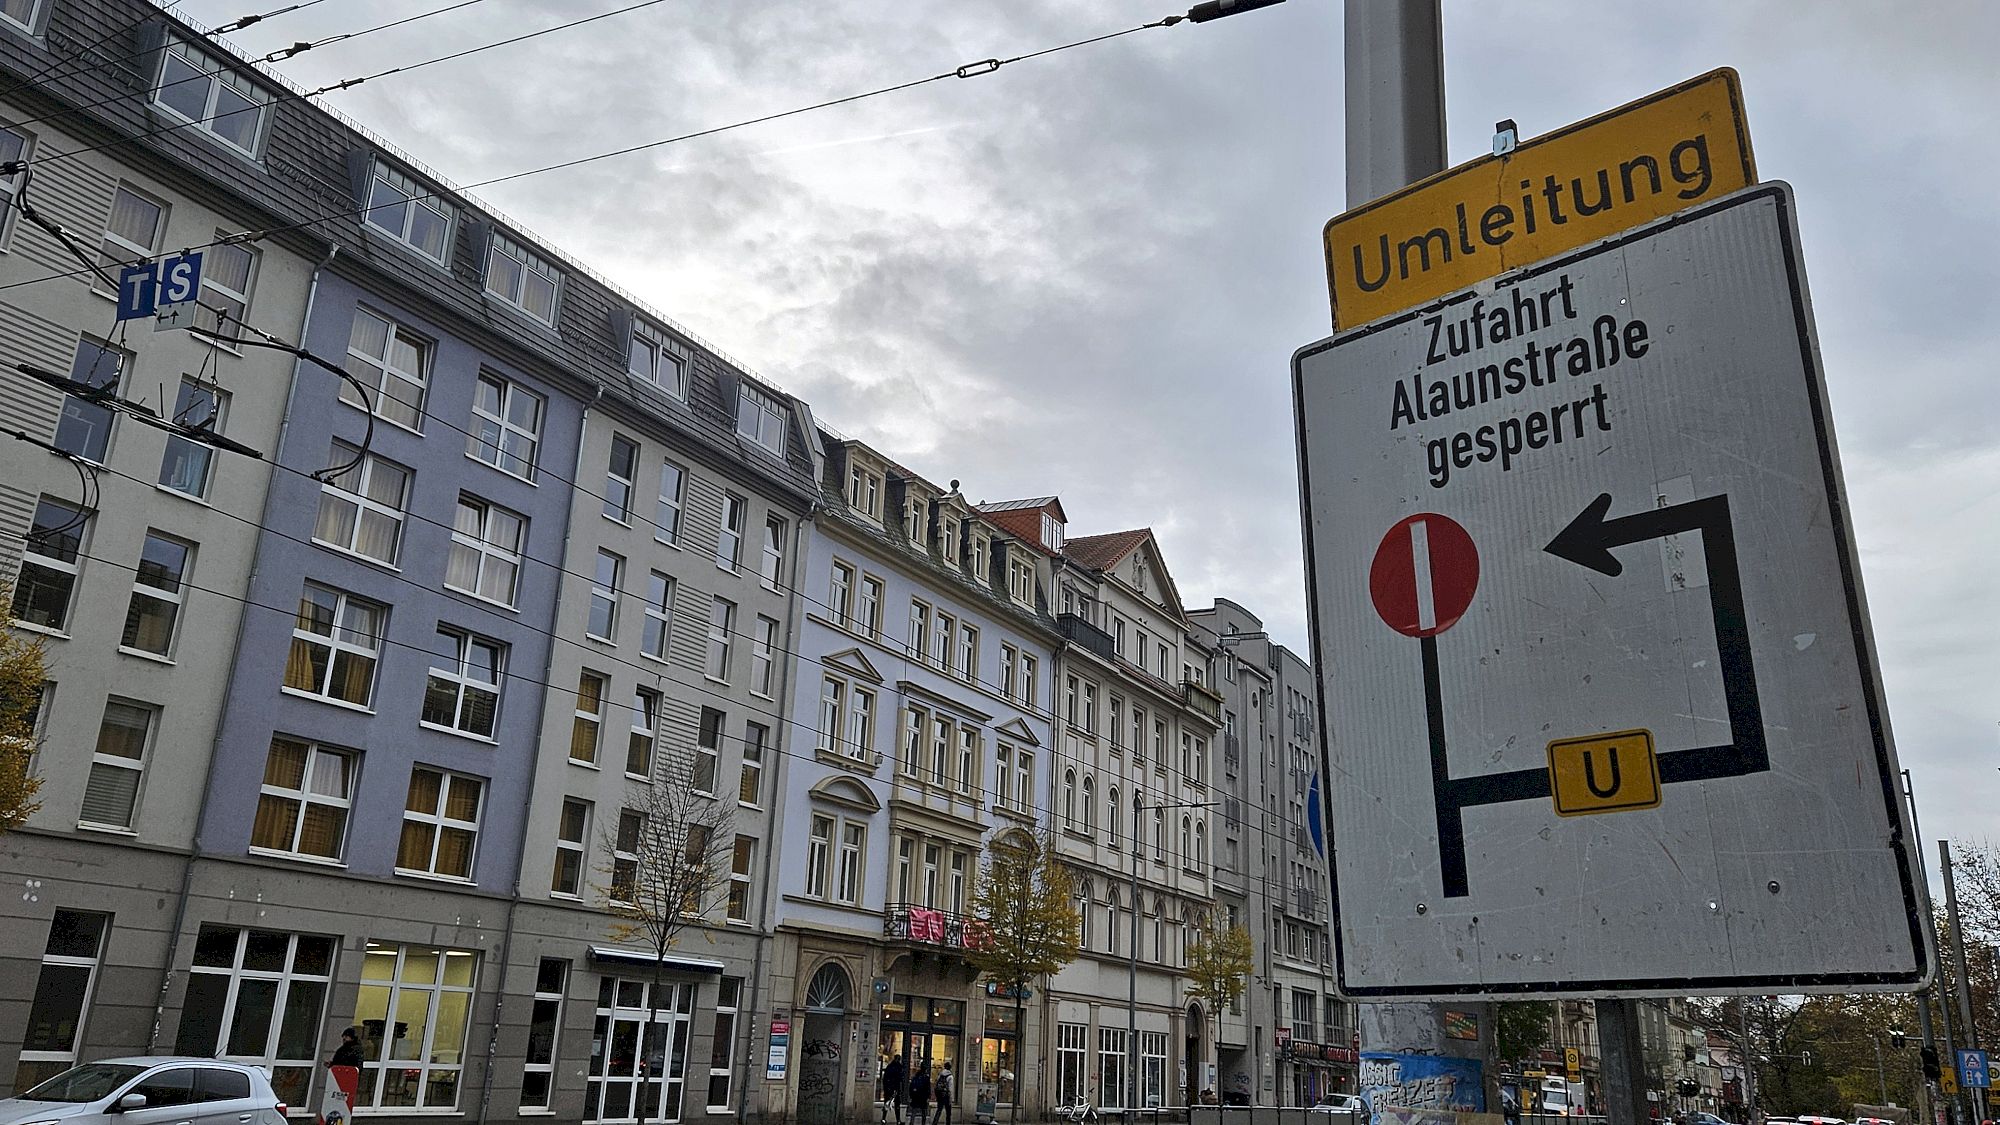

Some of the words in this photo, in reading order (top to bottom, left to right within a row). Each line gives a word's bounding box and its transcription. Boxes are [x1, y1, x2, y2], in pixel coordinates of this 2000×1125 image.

[1352, 133, 1713, 293] Umleitung
[127, 272, 150, 311] T
[167, 262, 192, 302] S
[1423, 274, 1577, 366] Zufahrt
[1390, 314, 1649, 431] Alaunstraße
[1426, 383, 1612, 489] gesperrt
[1583, 747, 1621, 799] U
